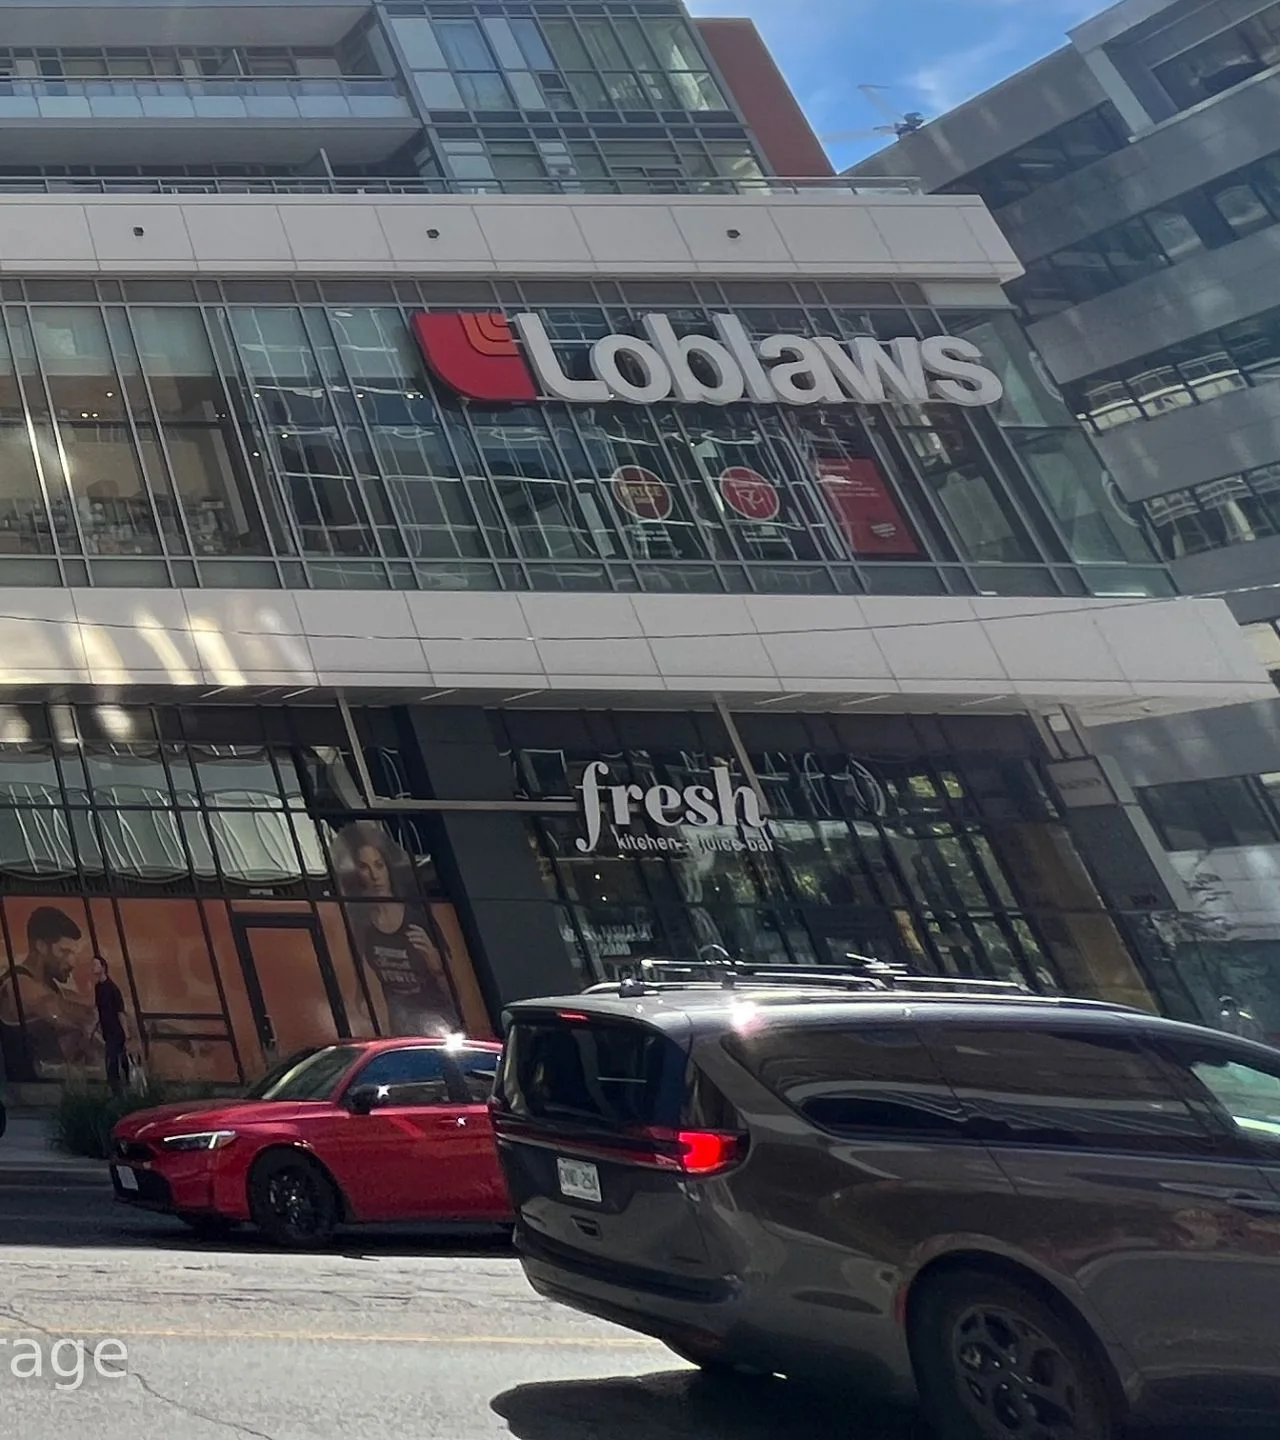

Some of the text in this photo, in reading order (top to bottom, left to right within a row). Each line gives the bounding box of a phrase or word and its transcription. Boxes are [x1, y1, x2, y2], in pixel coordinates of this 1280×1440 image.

[510, 312, 1004, 407] Loblaws
[574, 760, 769, 853] fresh
[616, 829, 677, 853] kitchen
[698, 831, 744, 856] juice
[746, 829, 775, 856] bar
